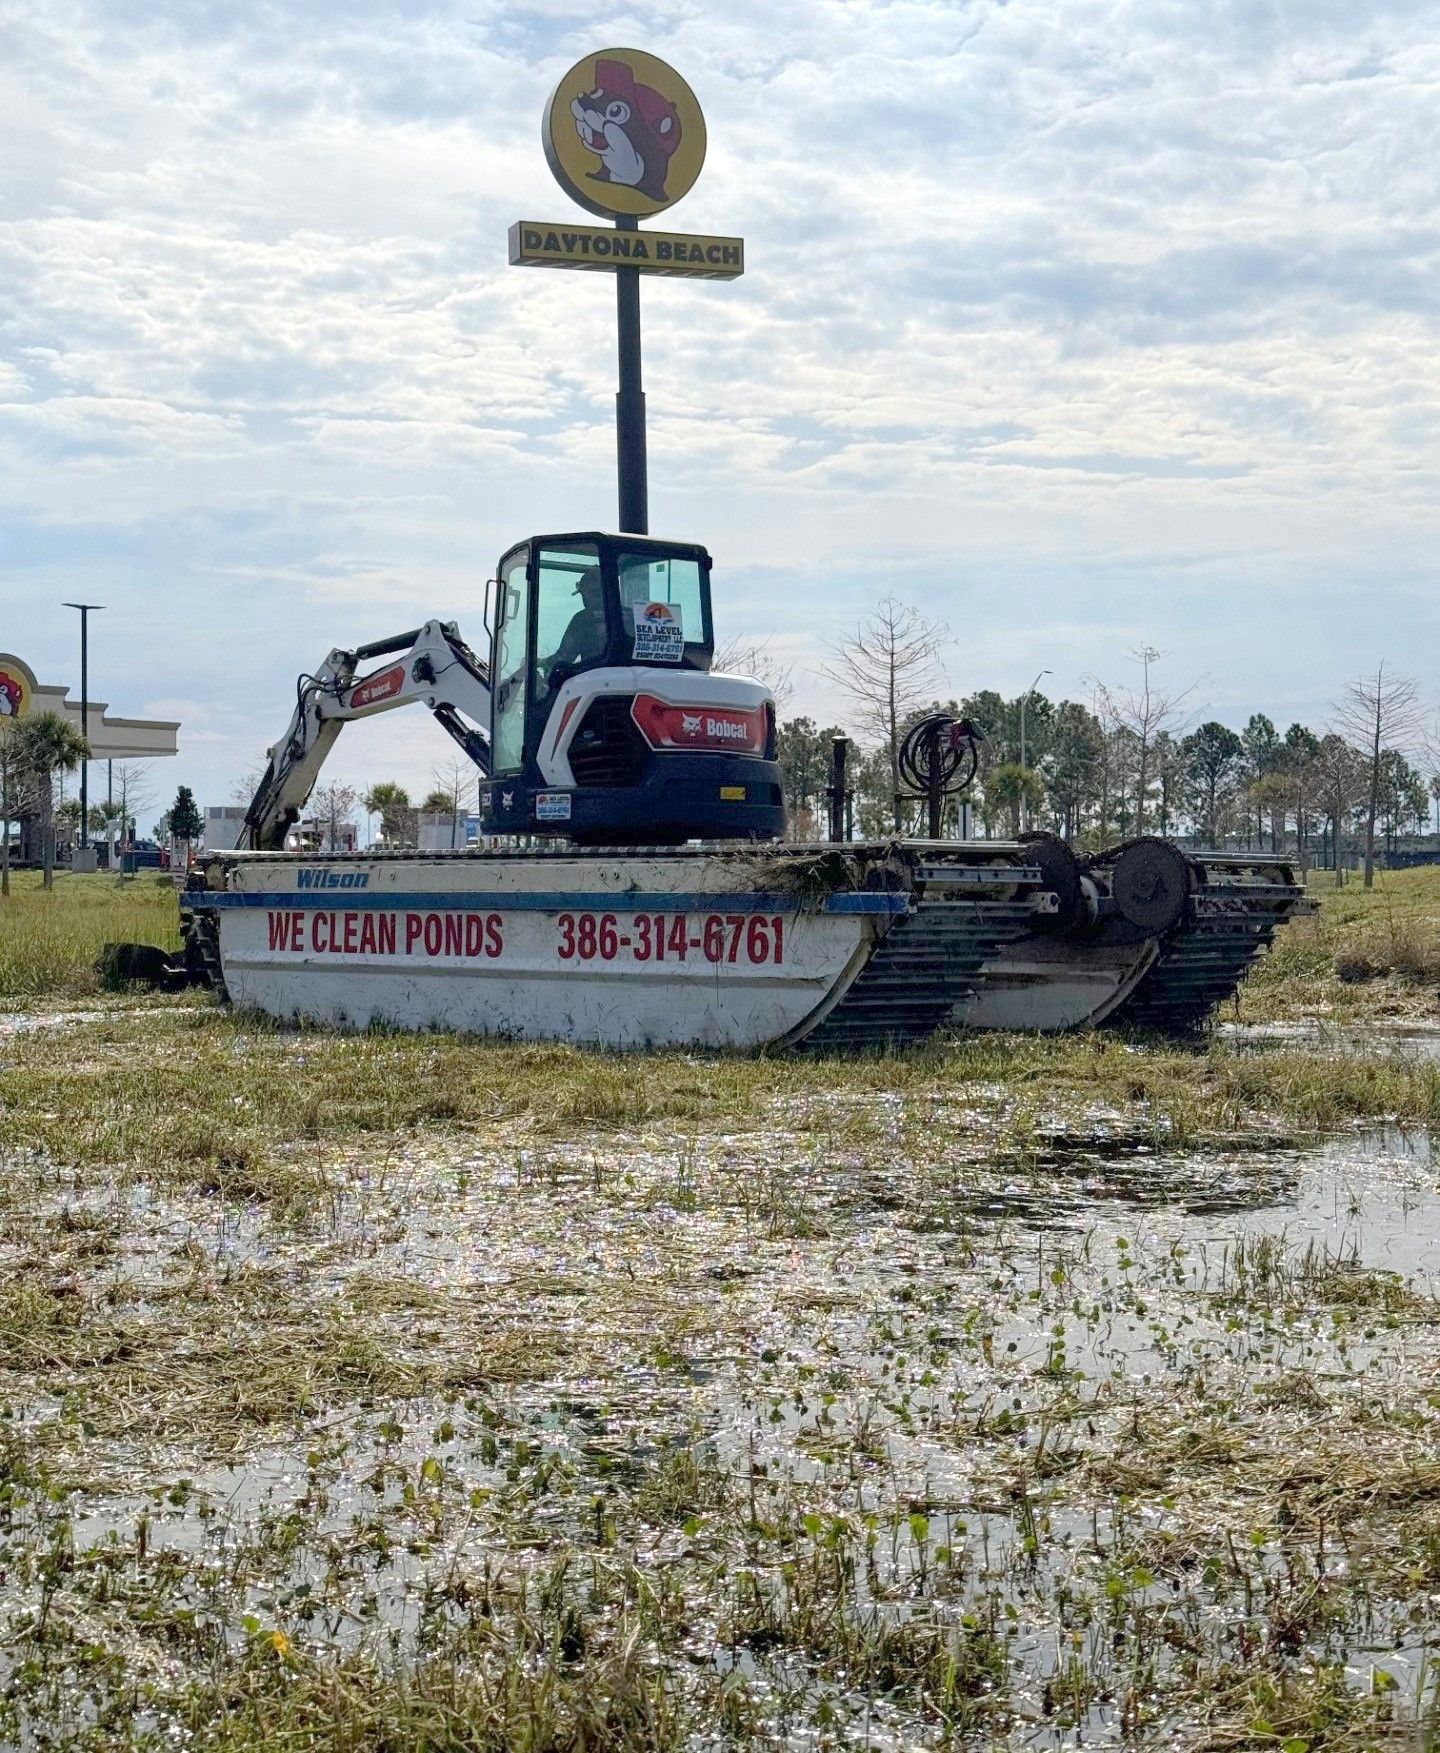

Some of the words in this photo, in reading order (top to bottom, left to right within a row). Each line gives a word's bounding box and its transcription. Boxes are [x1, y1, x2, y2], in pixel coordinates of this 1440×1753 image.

[524, 230, 649, 259] DAYTONA
[656, 240, 740, 265] BEACH
[636, 625, 653, 633] SEA
[656, 626, 682, 635] LEVEL
[706, 718, 747, 740] Bobcat
[297, 868, 369, 888] Wilson
[268, 911, 305, 951] WE
[312, 911, 396, 954] CLEAN
[405, 913, 503, 958] PONDS
[557, 913, 783, 964] 386-314-6761
